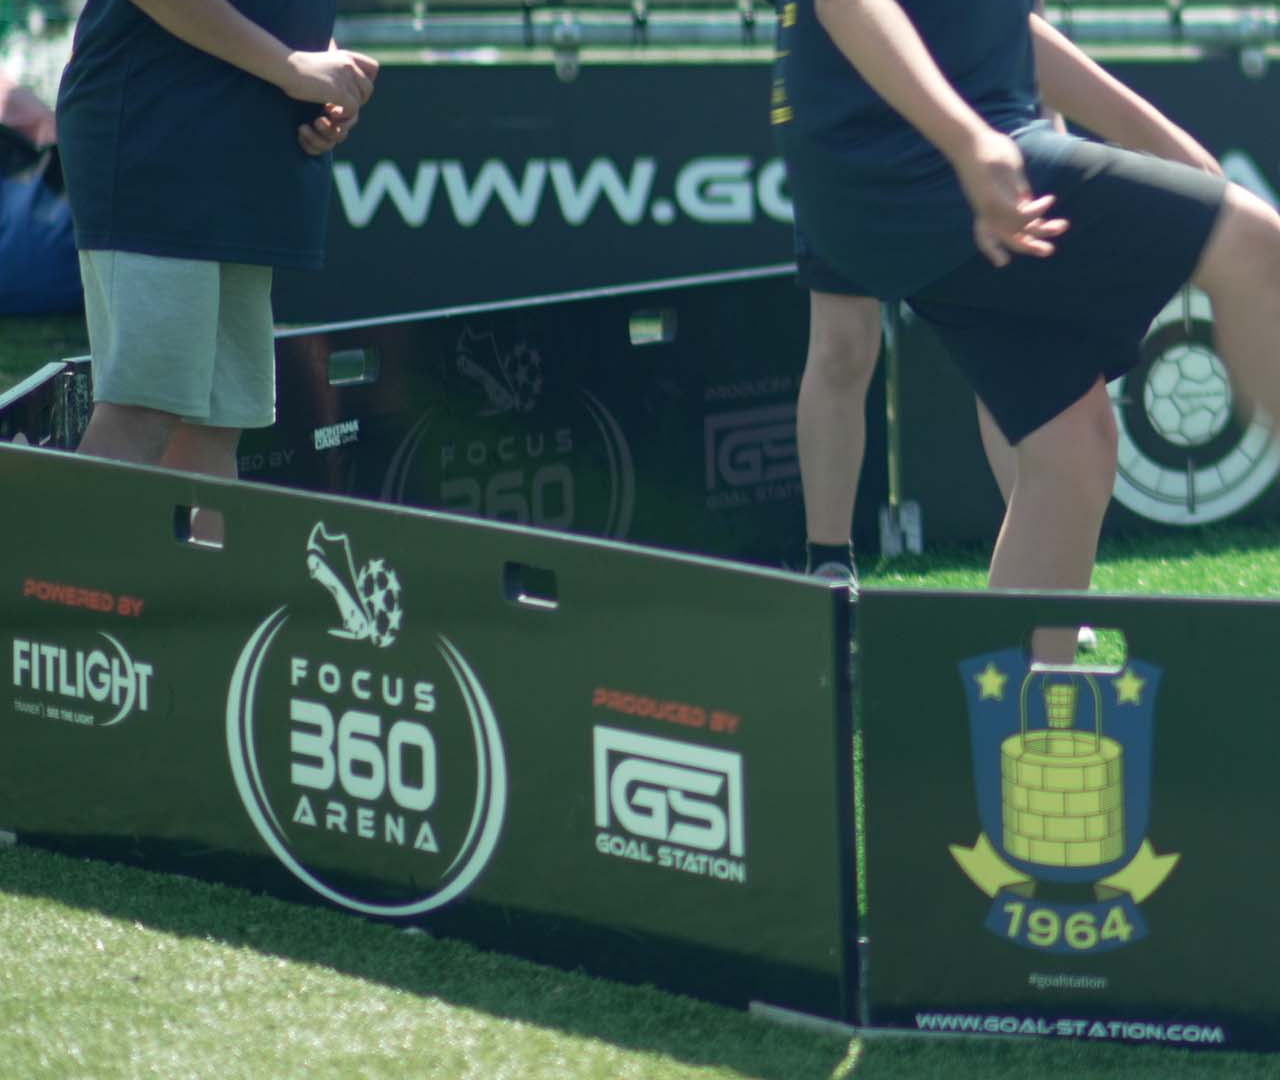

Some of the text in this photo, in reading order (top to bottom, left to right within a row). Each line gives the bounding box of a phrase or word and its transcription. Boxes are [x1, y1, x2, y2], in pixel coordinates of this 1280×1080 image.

[440, 427, 573, 470] FOCUS
[23, 577, 144, 617] POWERED BY
[13, 638, 153, 712] FITLIGHT
[290, 657, 437, 713] FOCUS
[592, 687, 742, 734] PRODUCED BY
[290, 697, 438, 813] 360
[293, 795, 440, 853] ARENA
[595, 832, 747, 884] GOAL STATION
[1001, 901, 1136, 953] 1964
[1028, 971, 1107, 990] #goalstation
[914, 1012, 1225, 1044] WWW.GOAL-STATION.COM
